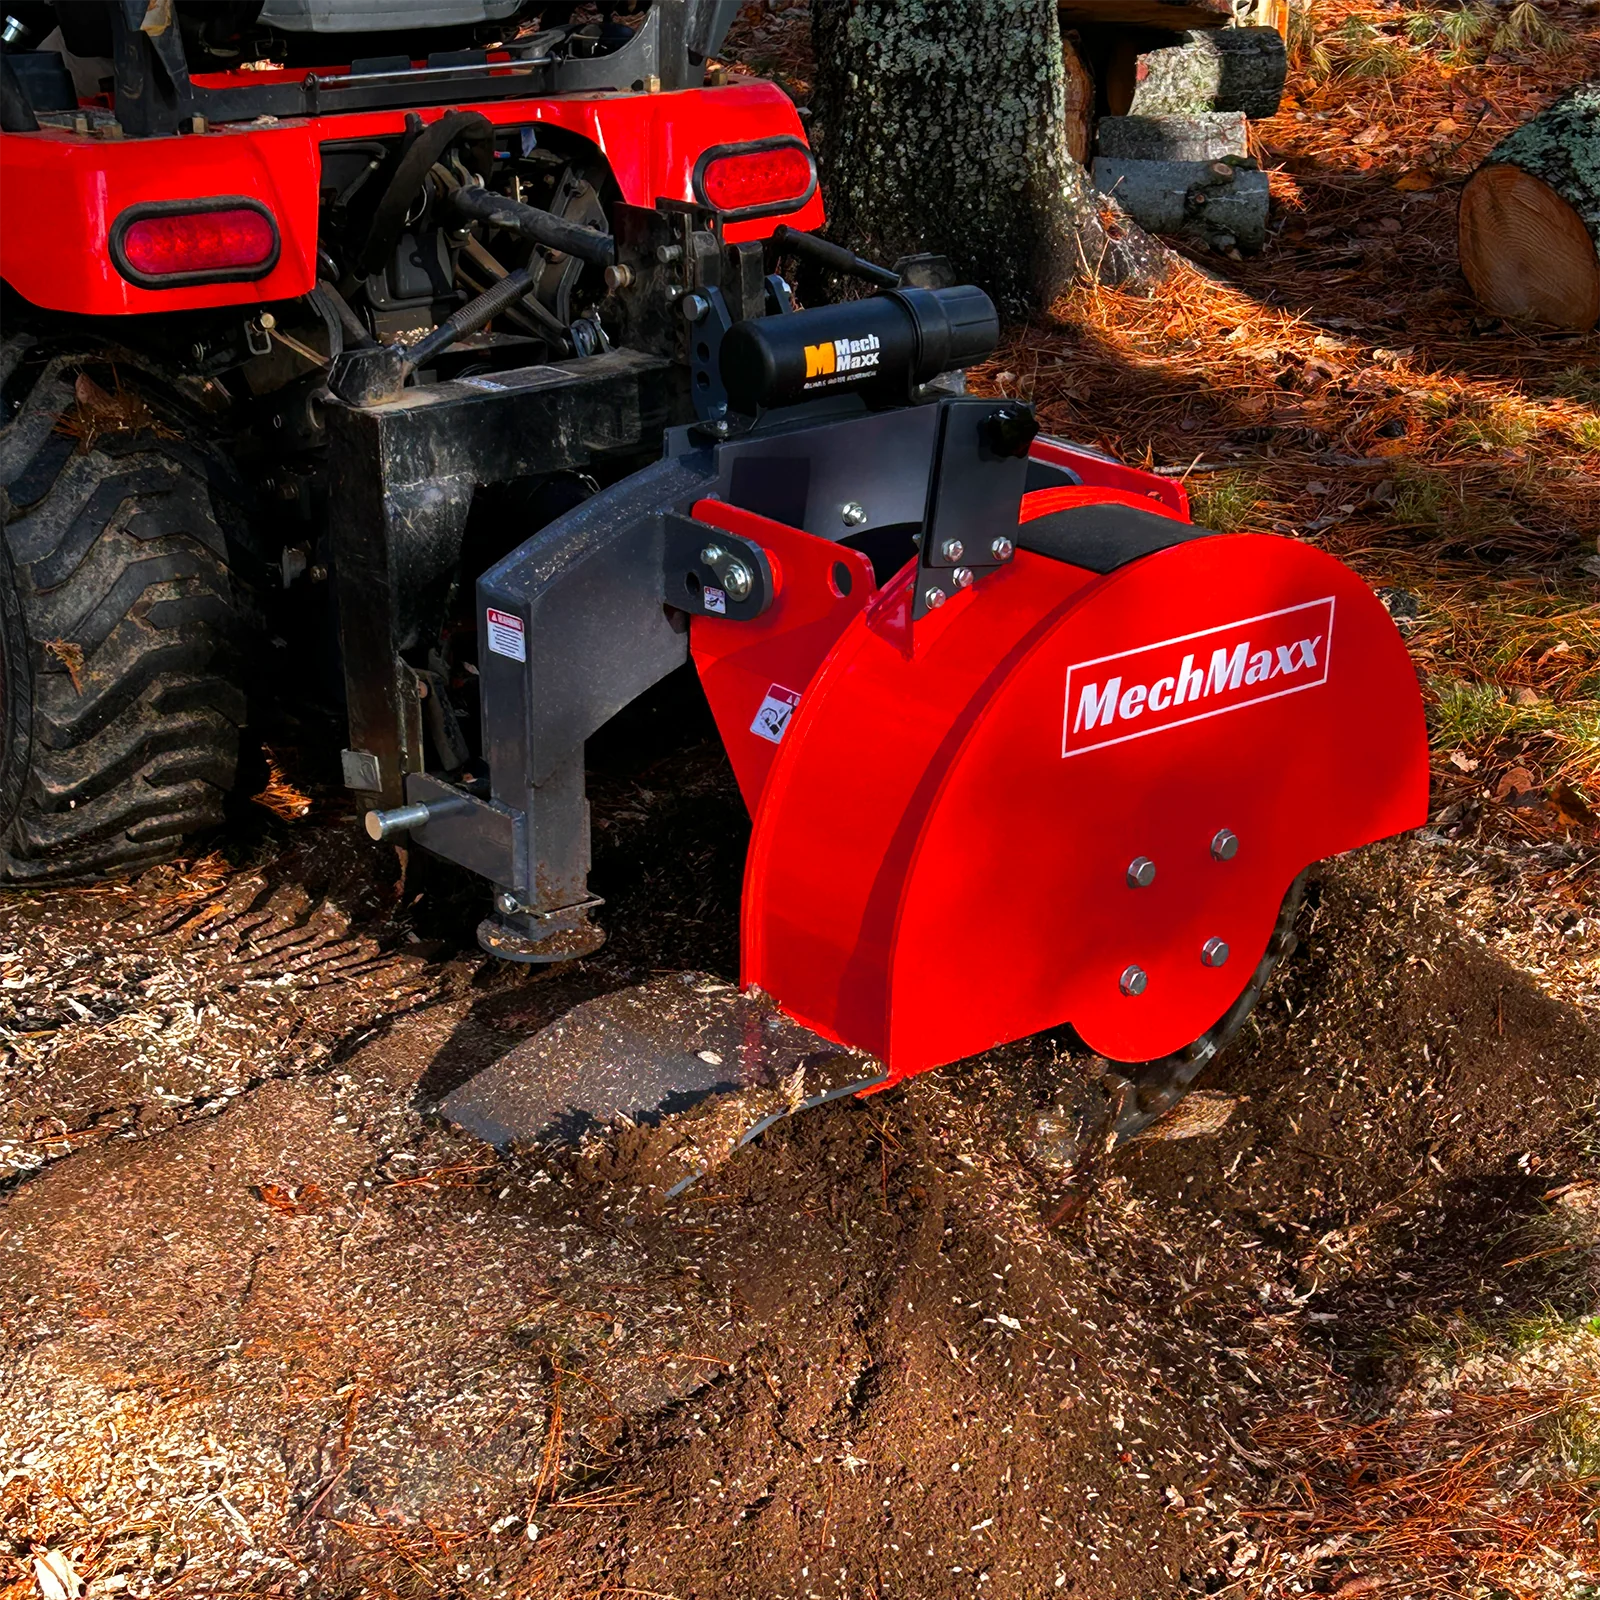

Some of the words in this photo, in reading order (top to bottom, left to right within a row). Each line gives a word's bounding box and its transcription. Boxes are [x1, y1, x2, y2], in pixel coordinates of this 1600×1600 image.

[834, 334, 880, 355] Mech
[836, 352, 880, 372] Maxx
[1073, 635, 1322, 734] MechMaxx
